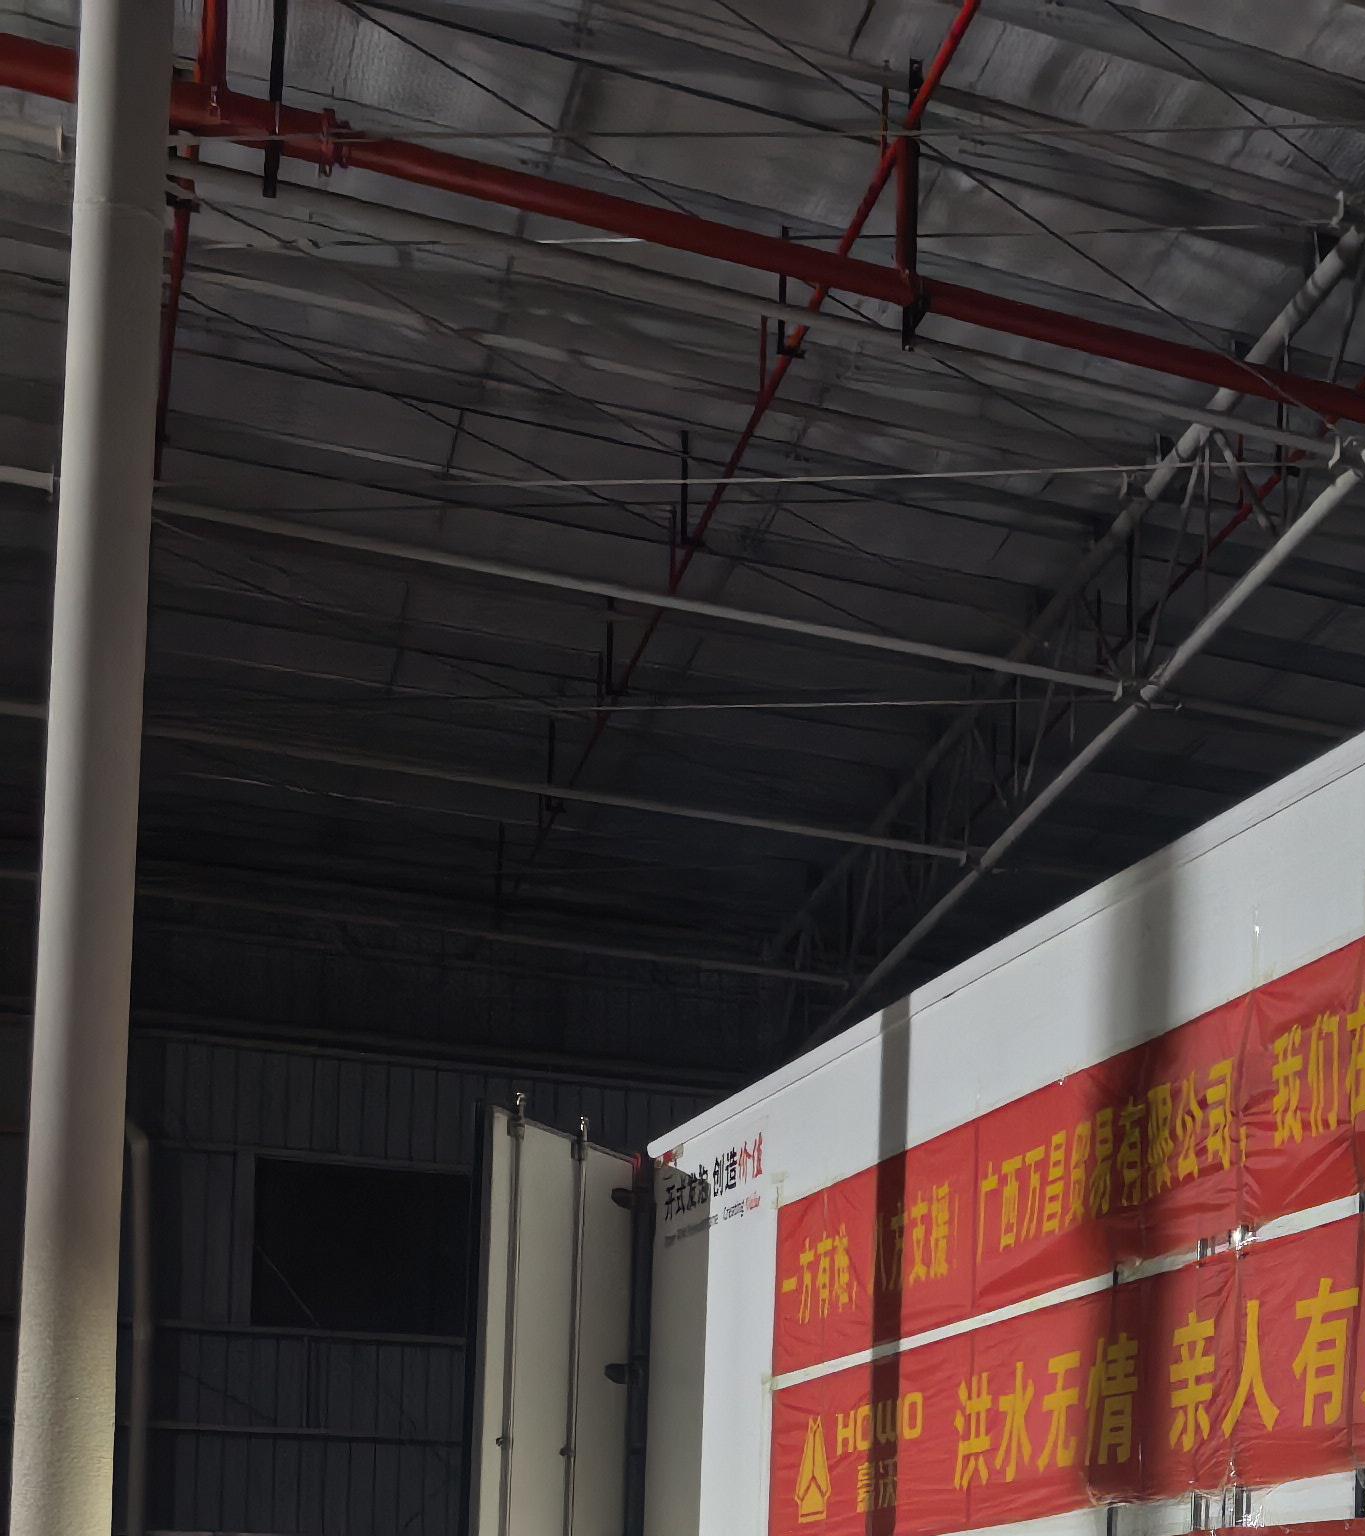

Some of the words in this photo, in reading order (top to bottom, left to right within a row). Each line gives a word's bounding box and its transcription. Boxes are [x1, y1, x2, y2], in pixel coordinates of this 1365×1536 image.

[836, 1394, 923, 1456] HOWO
[955, 1332, 1139, 1490] 洪水无情
